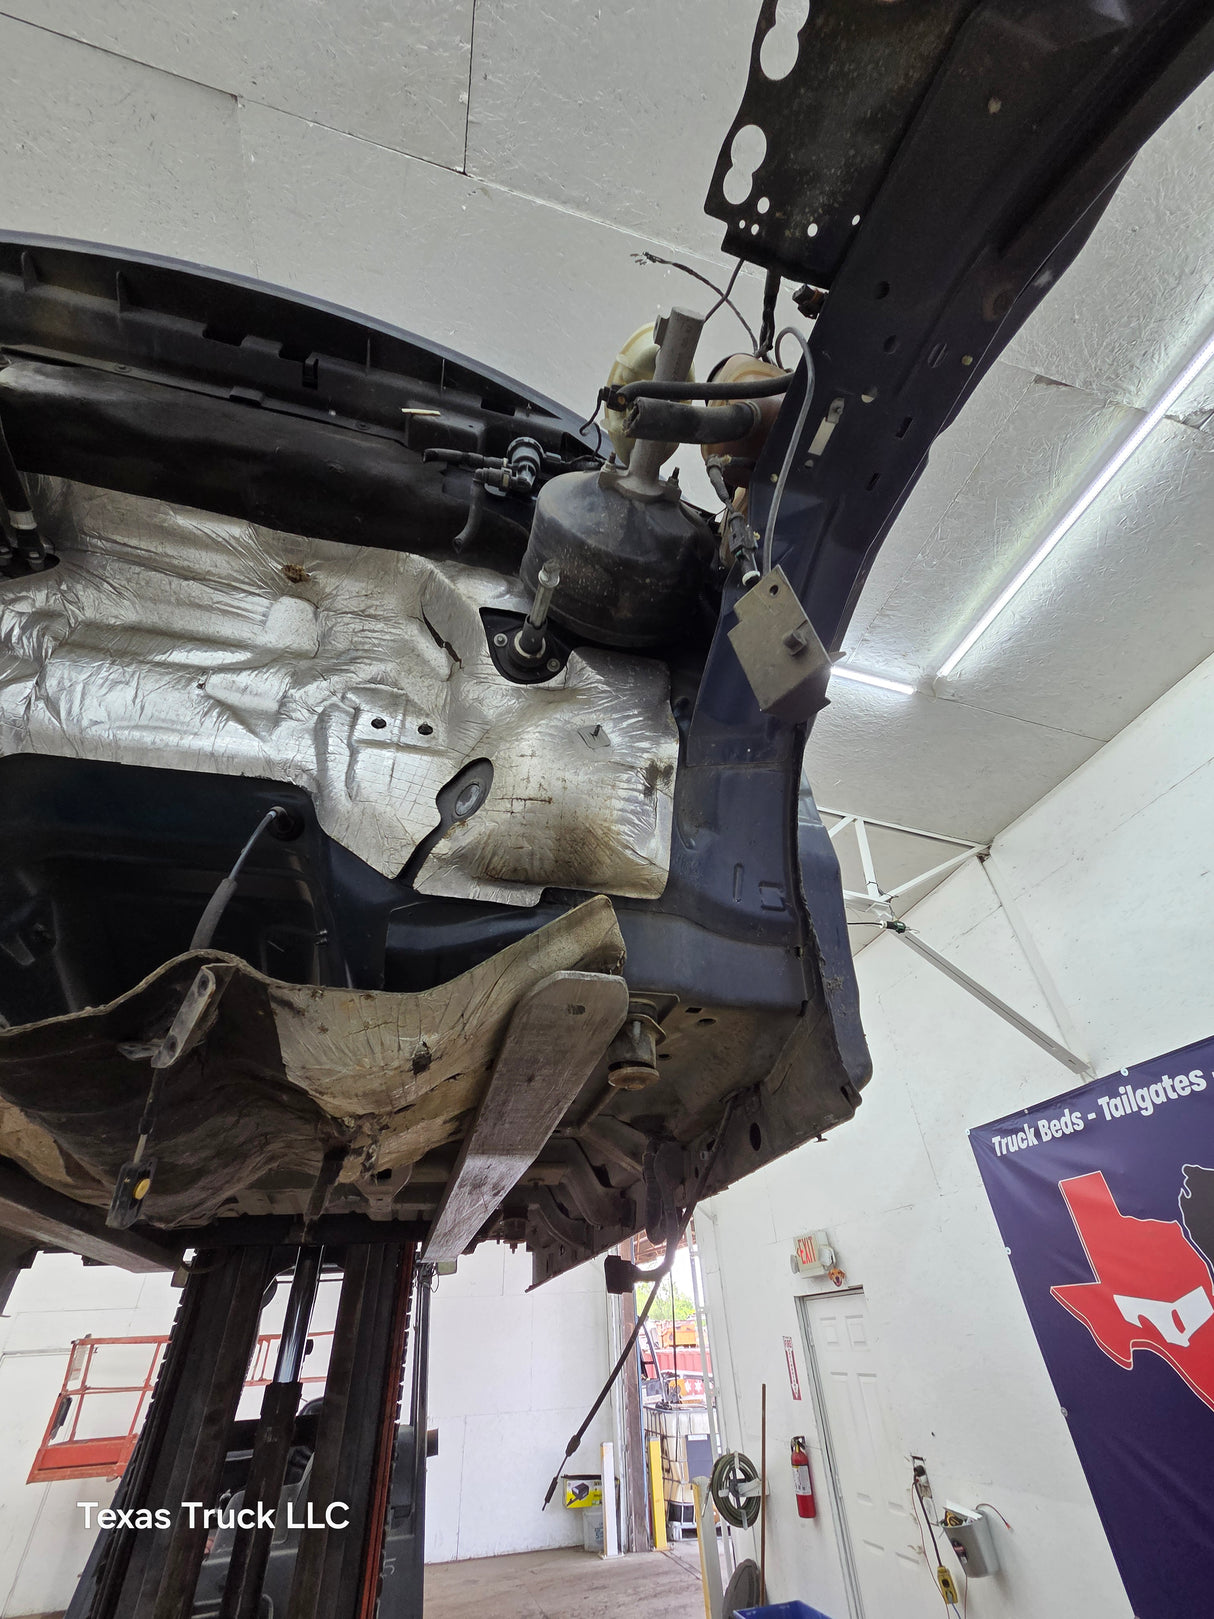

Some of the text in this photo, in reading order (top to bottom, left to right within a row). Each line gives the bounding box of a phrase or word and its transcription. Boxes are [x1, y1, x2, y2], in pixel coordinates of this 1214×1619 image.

[992, 1123, 1039, 1157] Truck
[1037, 1108, 1085, 1143] Beds
[1097, 1069, 1207, 1121] Tailgates
[797, 1236, 817, 1265] EXIT
